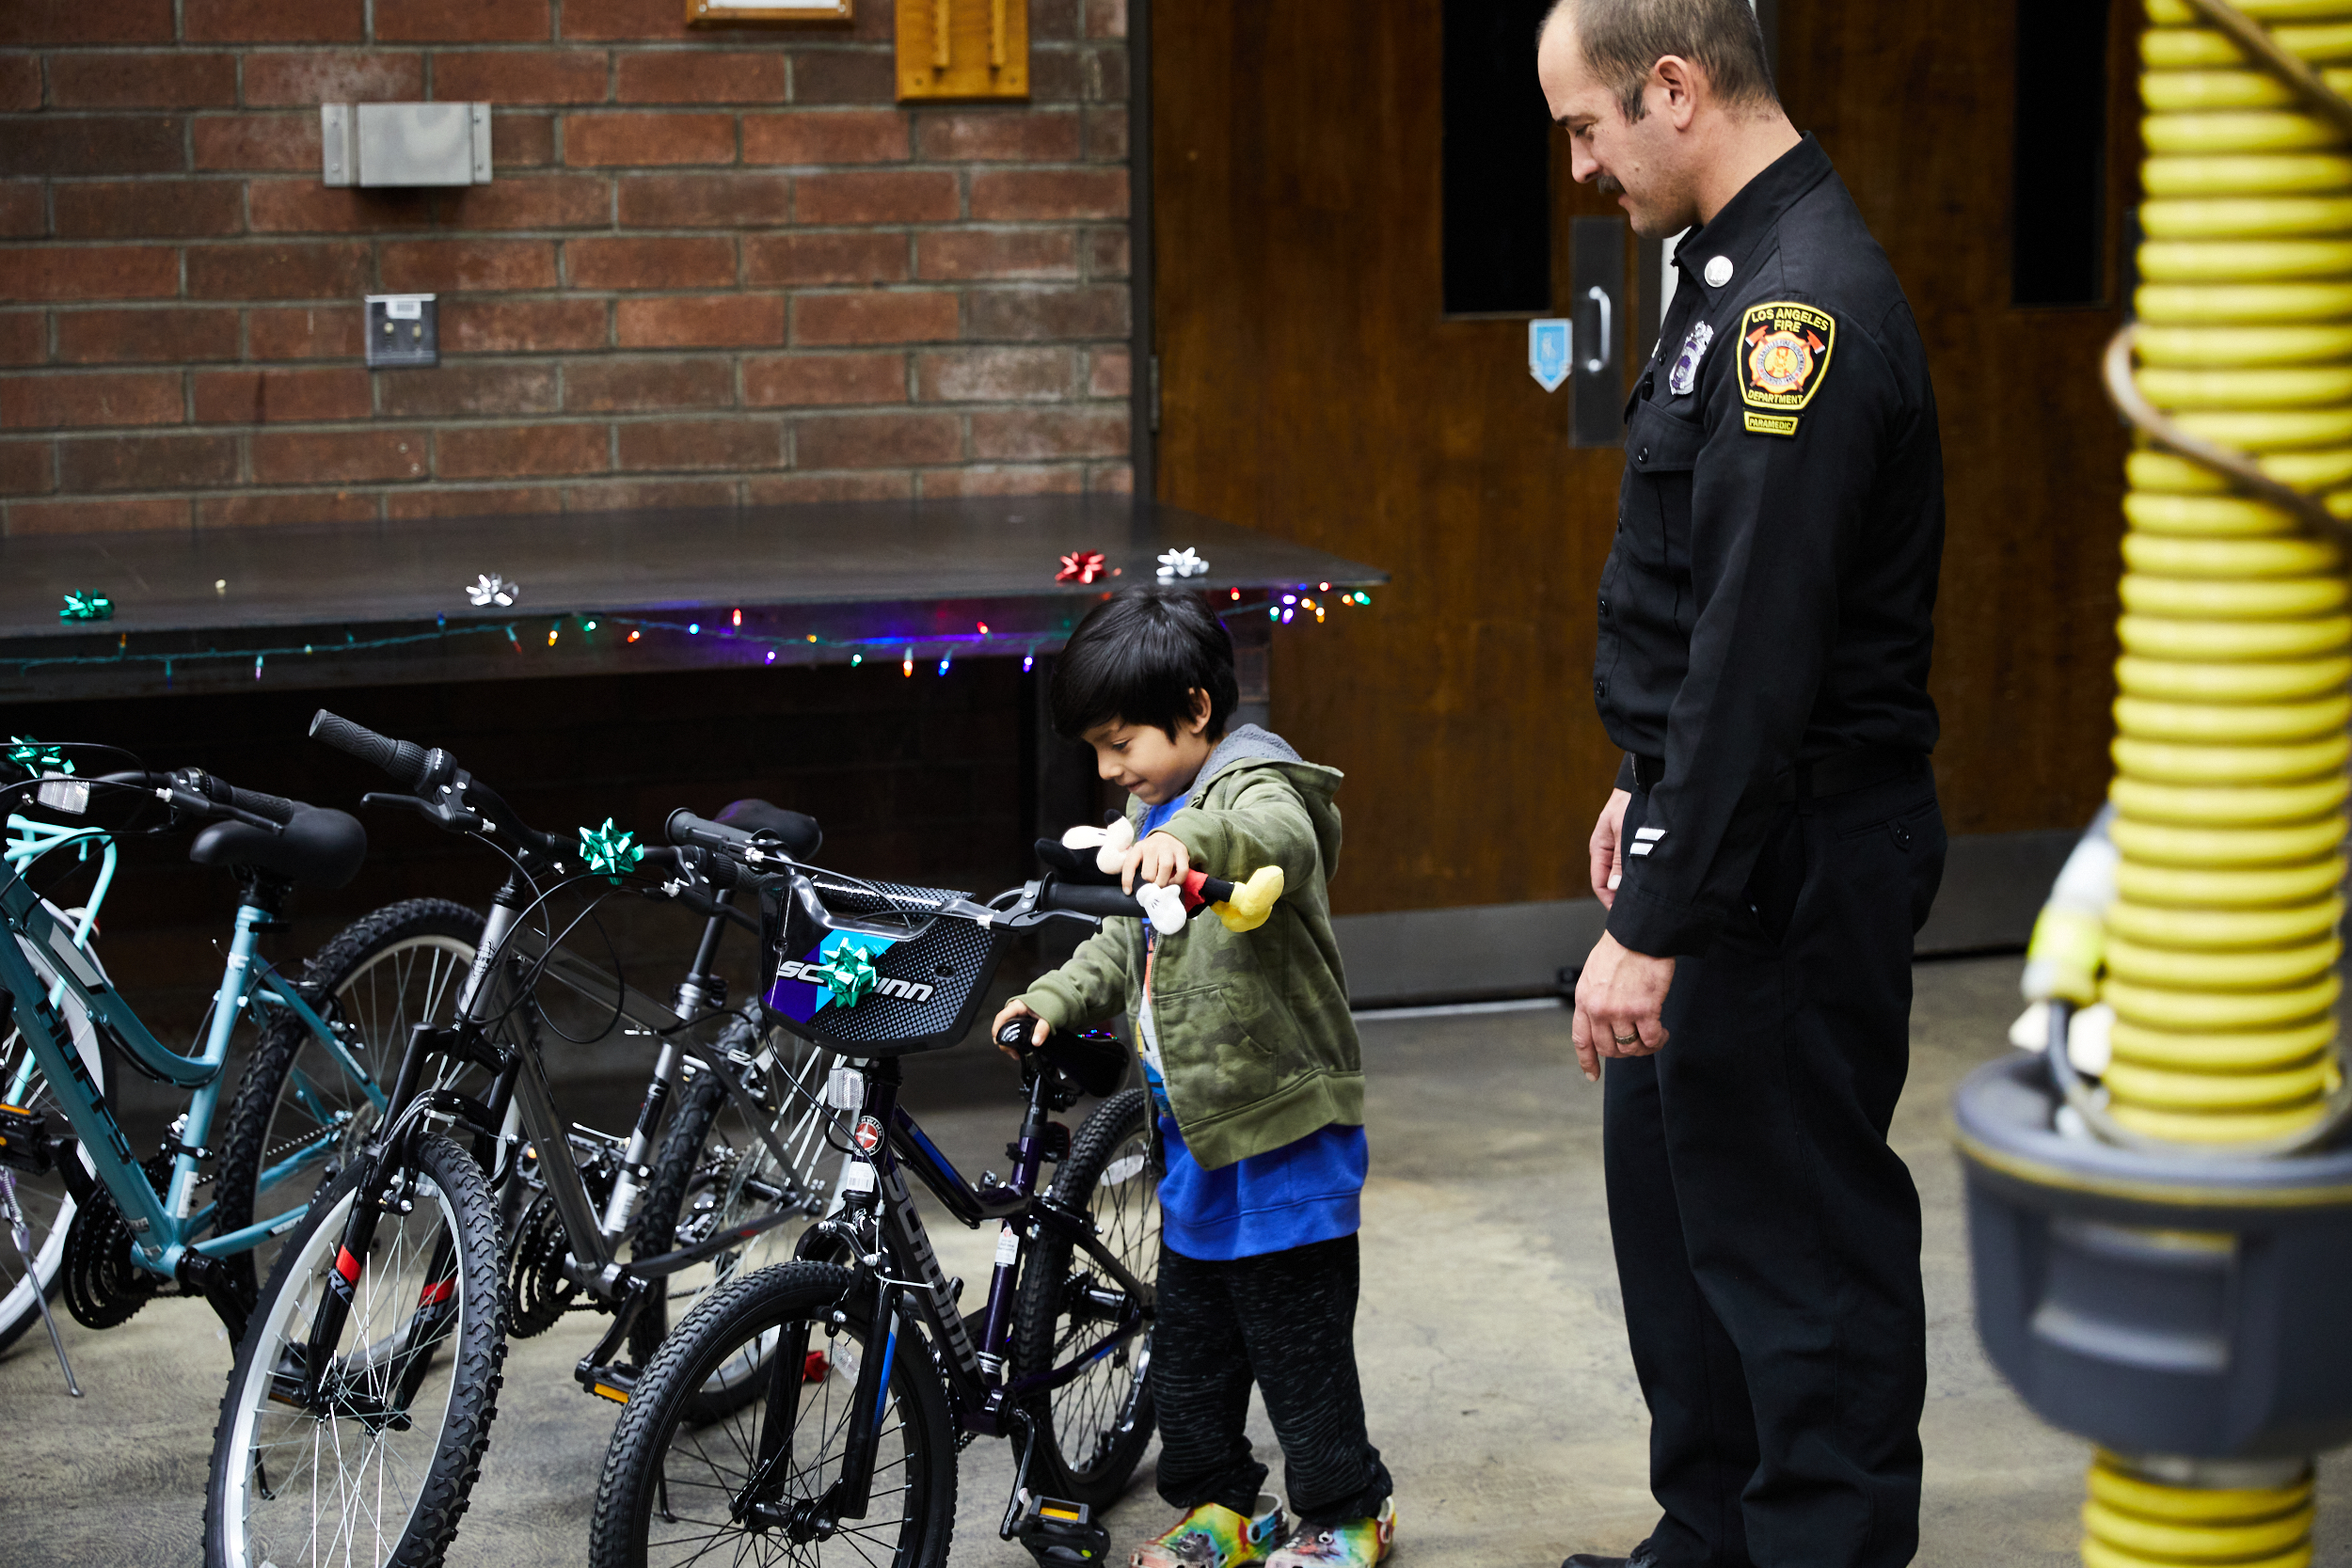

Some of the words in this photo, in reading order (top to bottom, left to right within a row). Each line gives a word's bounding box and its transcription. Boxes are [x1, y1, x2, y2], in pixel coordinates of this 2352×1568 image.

[1751, 309, 1774, 323] LOS
[1775, 308, 1830, 331] ANGELES
[1774, 320, 1802, 333] FIRE
[1748, 389, 1804, 404] DEPARTMENT
[1749, 419, 1792, 431] PARAMEDIC
[777, 959, 934, 1003] SCINN
